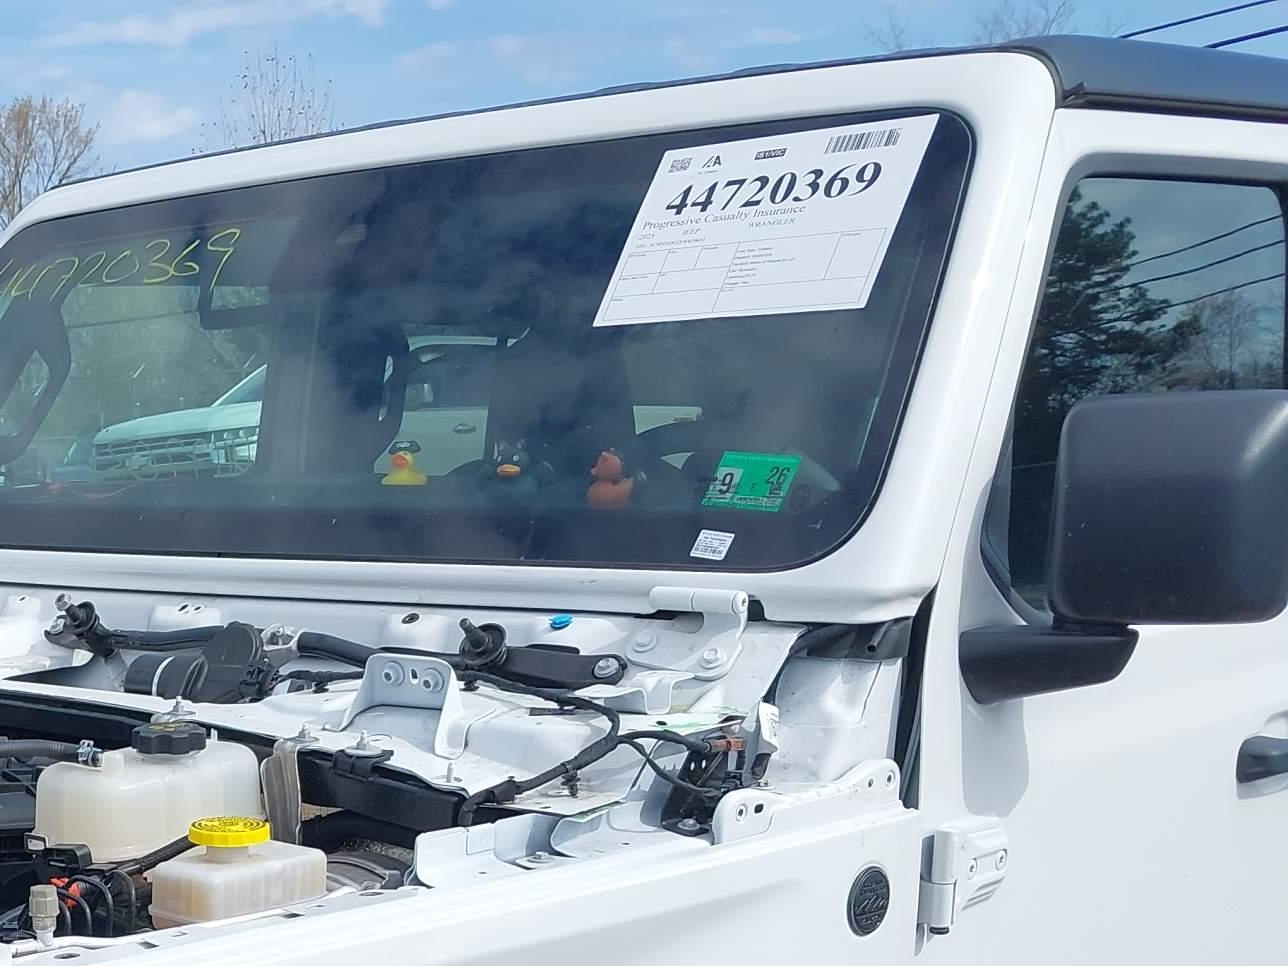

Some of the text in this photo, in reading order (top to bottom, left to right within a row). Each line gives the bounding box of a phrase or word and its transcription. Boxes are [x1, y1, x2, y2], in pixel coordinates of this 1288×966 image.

[665, 161, 882, 216] 44720369
[642, 205, 807, 231] Progressive Casualty Insurance
[748, 217, 796, 229] WRANGLER
[765, 466, 791, 485] 26
